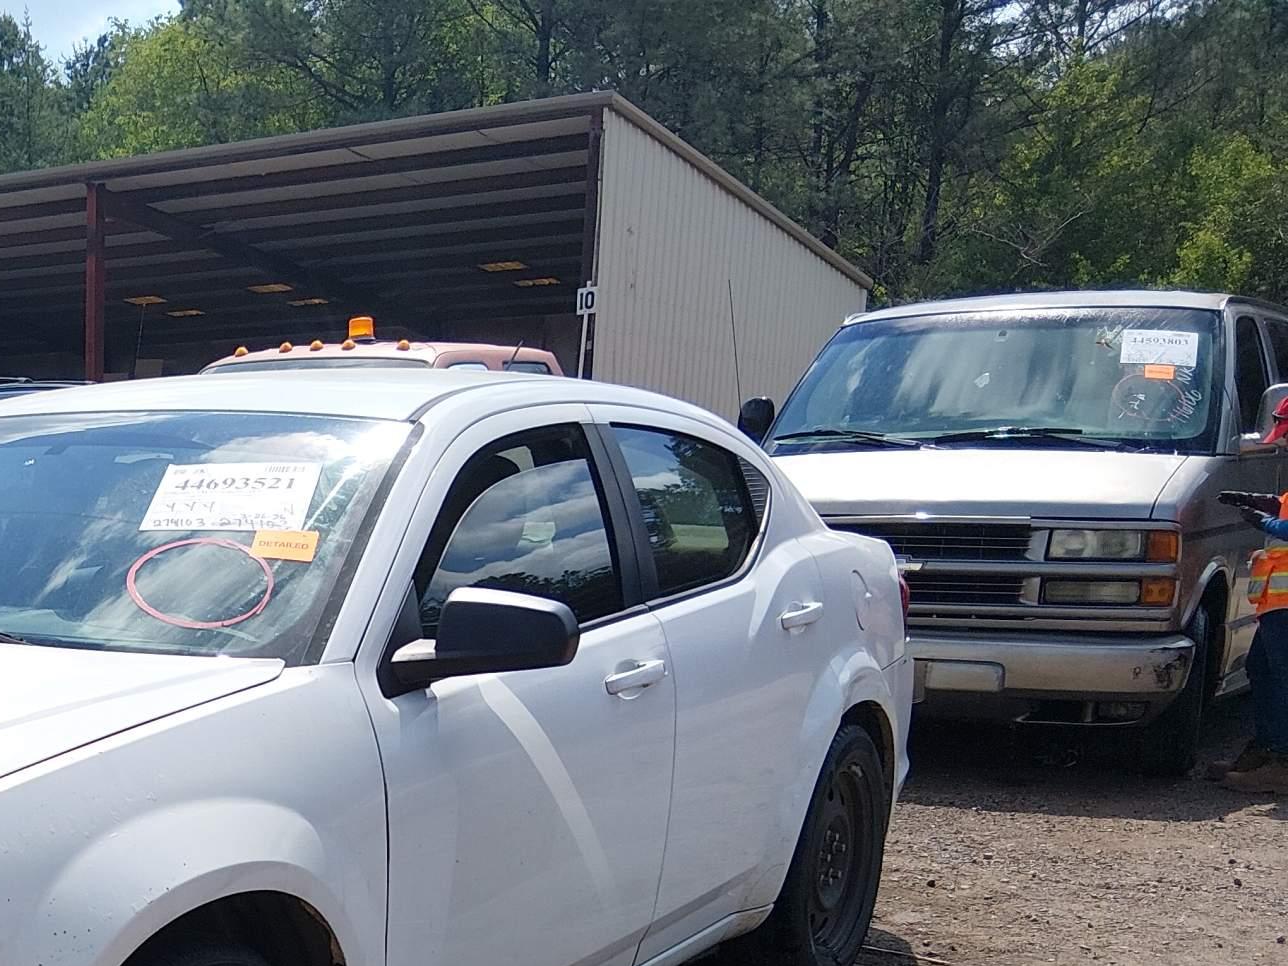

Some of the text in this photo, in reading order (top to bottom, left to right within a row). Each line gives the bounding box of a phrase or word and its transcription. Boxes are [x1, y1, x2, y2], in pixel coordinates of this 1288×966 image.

[579, 291, 595, 310] 10
[175, 477, 296, 491] 44693521
[258, 540, 309, 550] DETAILED
